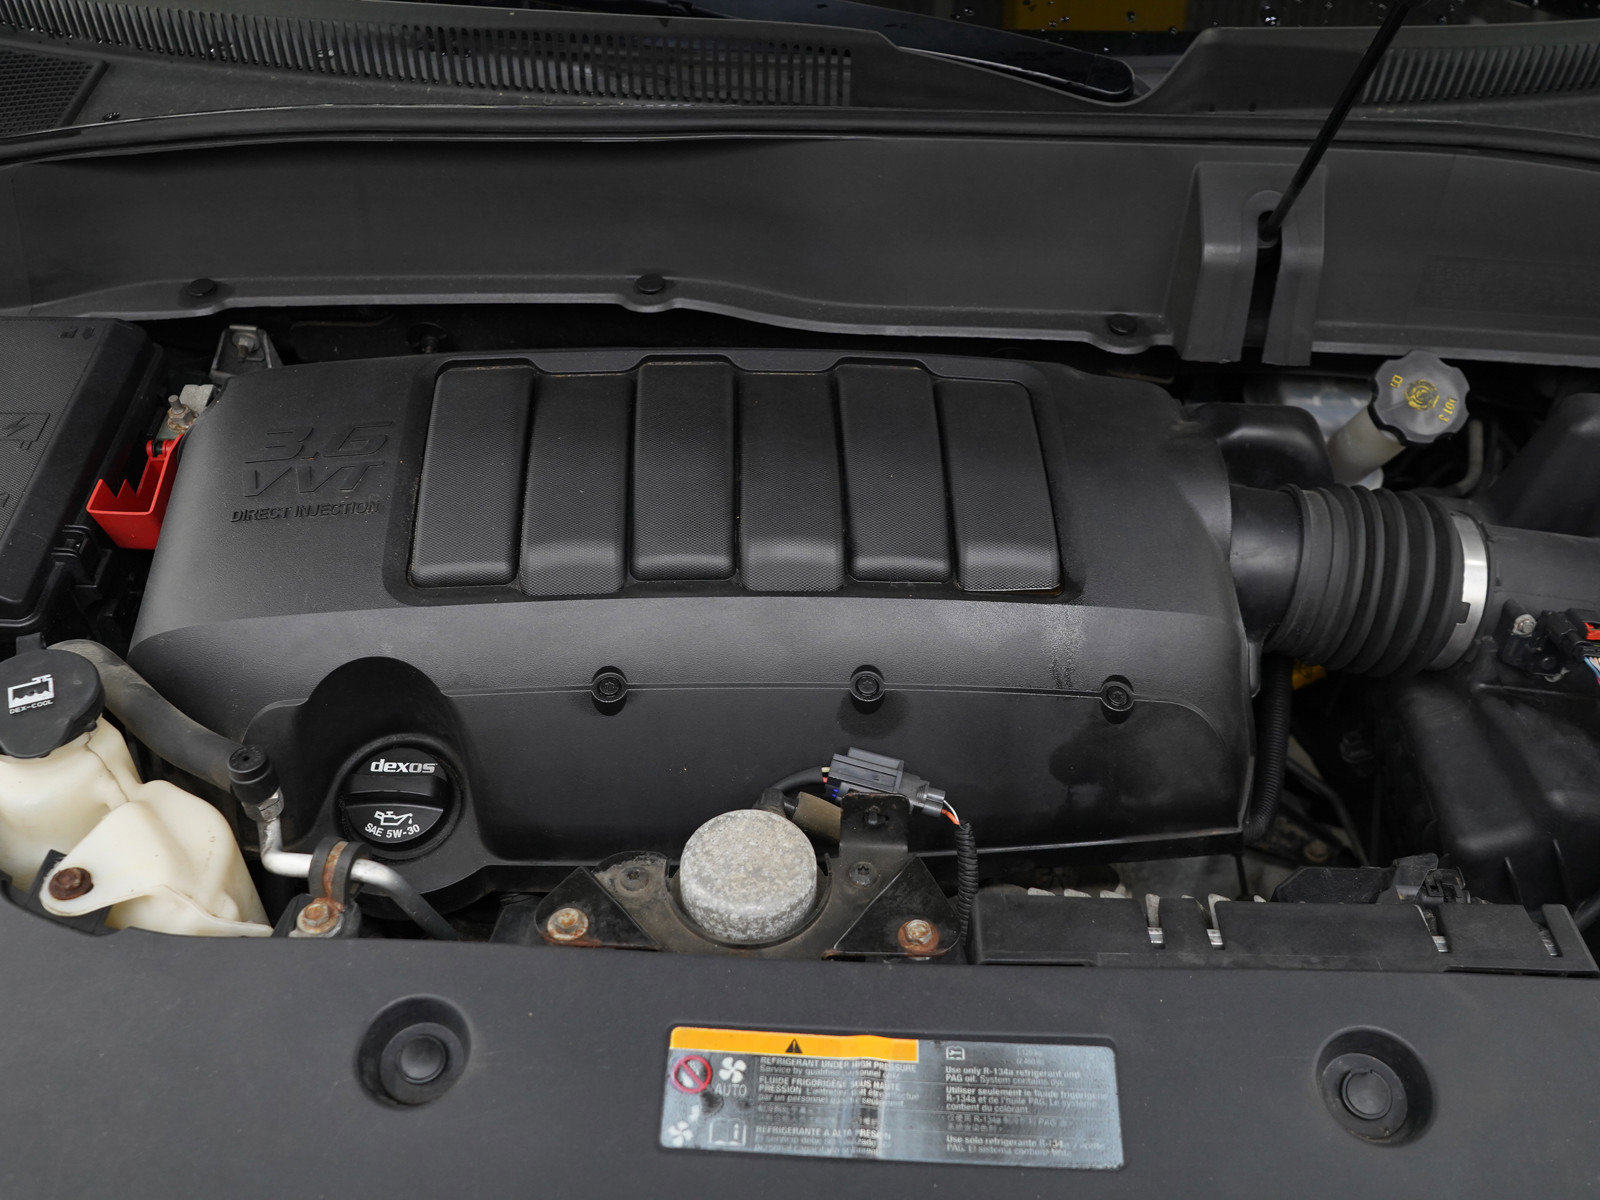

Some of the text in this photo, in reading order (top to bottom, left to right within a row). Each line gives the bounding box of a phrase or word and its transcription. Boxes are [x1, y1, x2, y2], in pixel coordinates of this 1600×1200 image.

[245, 421, 393, 464] 3.6
[244, 461, 386, 498] VVT
[231, 501, 381, 523] DIRECT INJECTION
[9, 700, 54, 714] DEX-COOL
[370, 758, 436, 774] dexos
[364, 822, 421, 839] SAE 5W-30
[760, 1056, 820, 1068] REFRIGERANT
[821, 1060, 850, 1070] UNDER
[760, 1064, 791, 1074] Service
[792, 1066, 803, 1075] by
[945, 1065, 961, 1074] Use
[962, 1066, 981, 1076] only
[983, 1066, 1014, 1076] R-134a
[759, 1075, 790, 1085] FLUIDE
[945, 1073, 963, 1083] PAG
[979, 1075, 1011, 1085] System
[715, 1083, 747, 1098] AUTO
[945, 1085, 976, 1095] Utiliser
[977, 1087, 1022, 1096] seulement
[945, 1093, 977, 1103] R-134a
[945, 1103, 980, 1112] contient
[981, 1104, 993, 1113] du
[945, 1134, 963, 1144] Use
